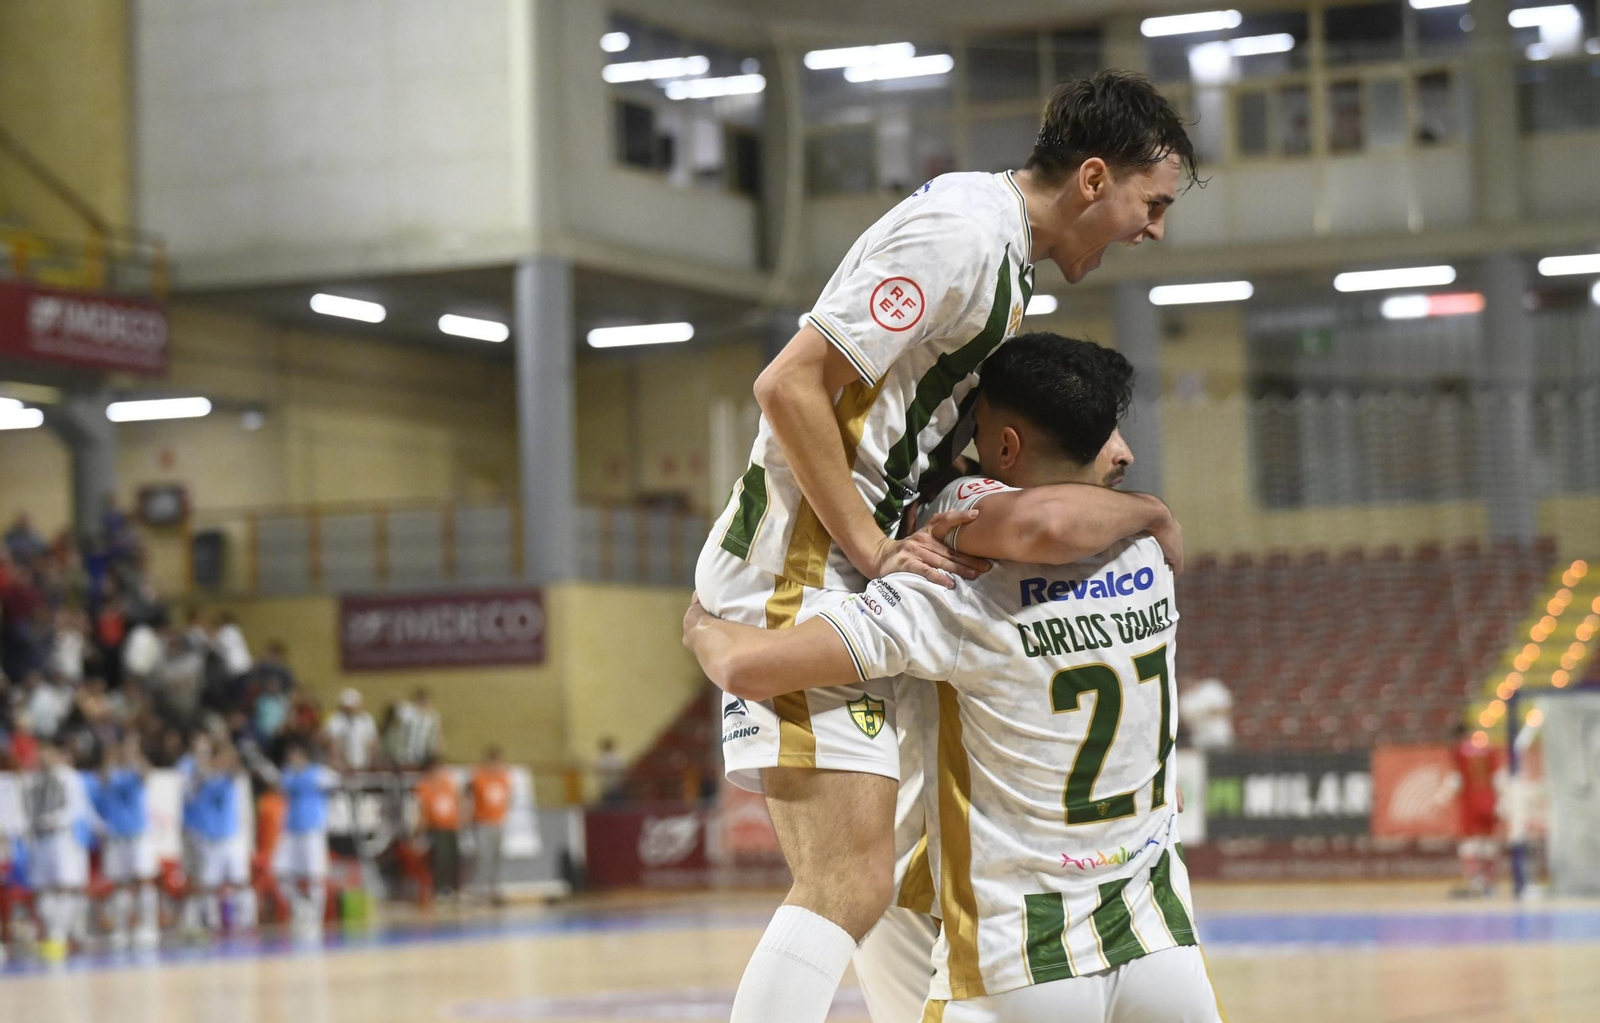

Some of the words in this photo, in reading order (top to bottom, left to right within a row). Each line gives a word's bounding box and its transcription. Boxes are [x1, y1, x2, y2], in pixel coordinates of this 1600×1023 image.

[1020, 566, 1154, 608] Revalco
[1017, 613, 1113, 658] CARLOS
[1110, 597, 1173, 645] GÓMEZ
[1049, 643, 1174, 825] 27
